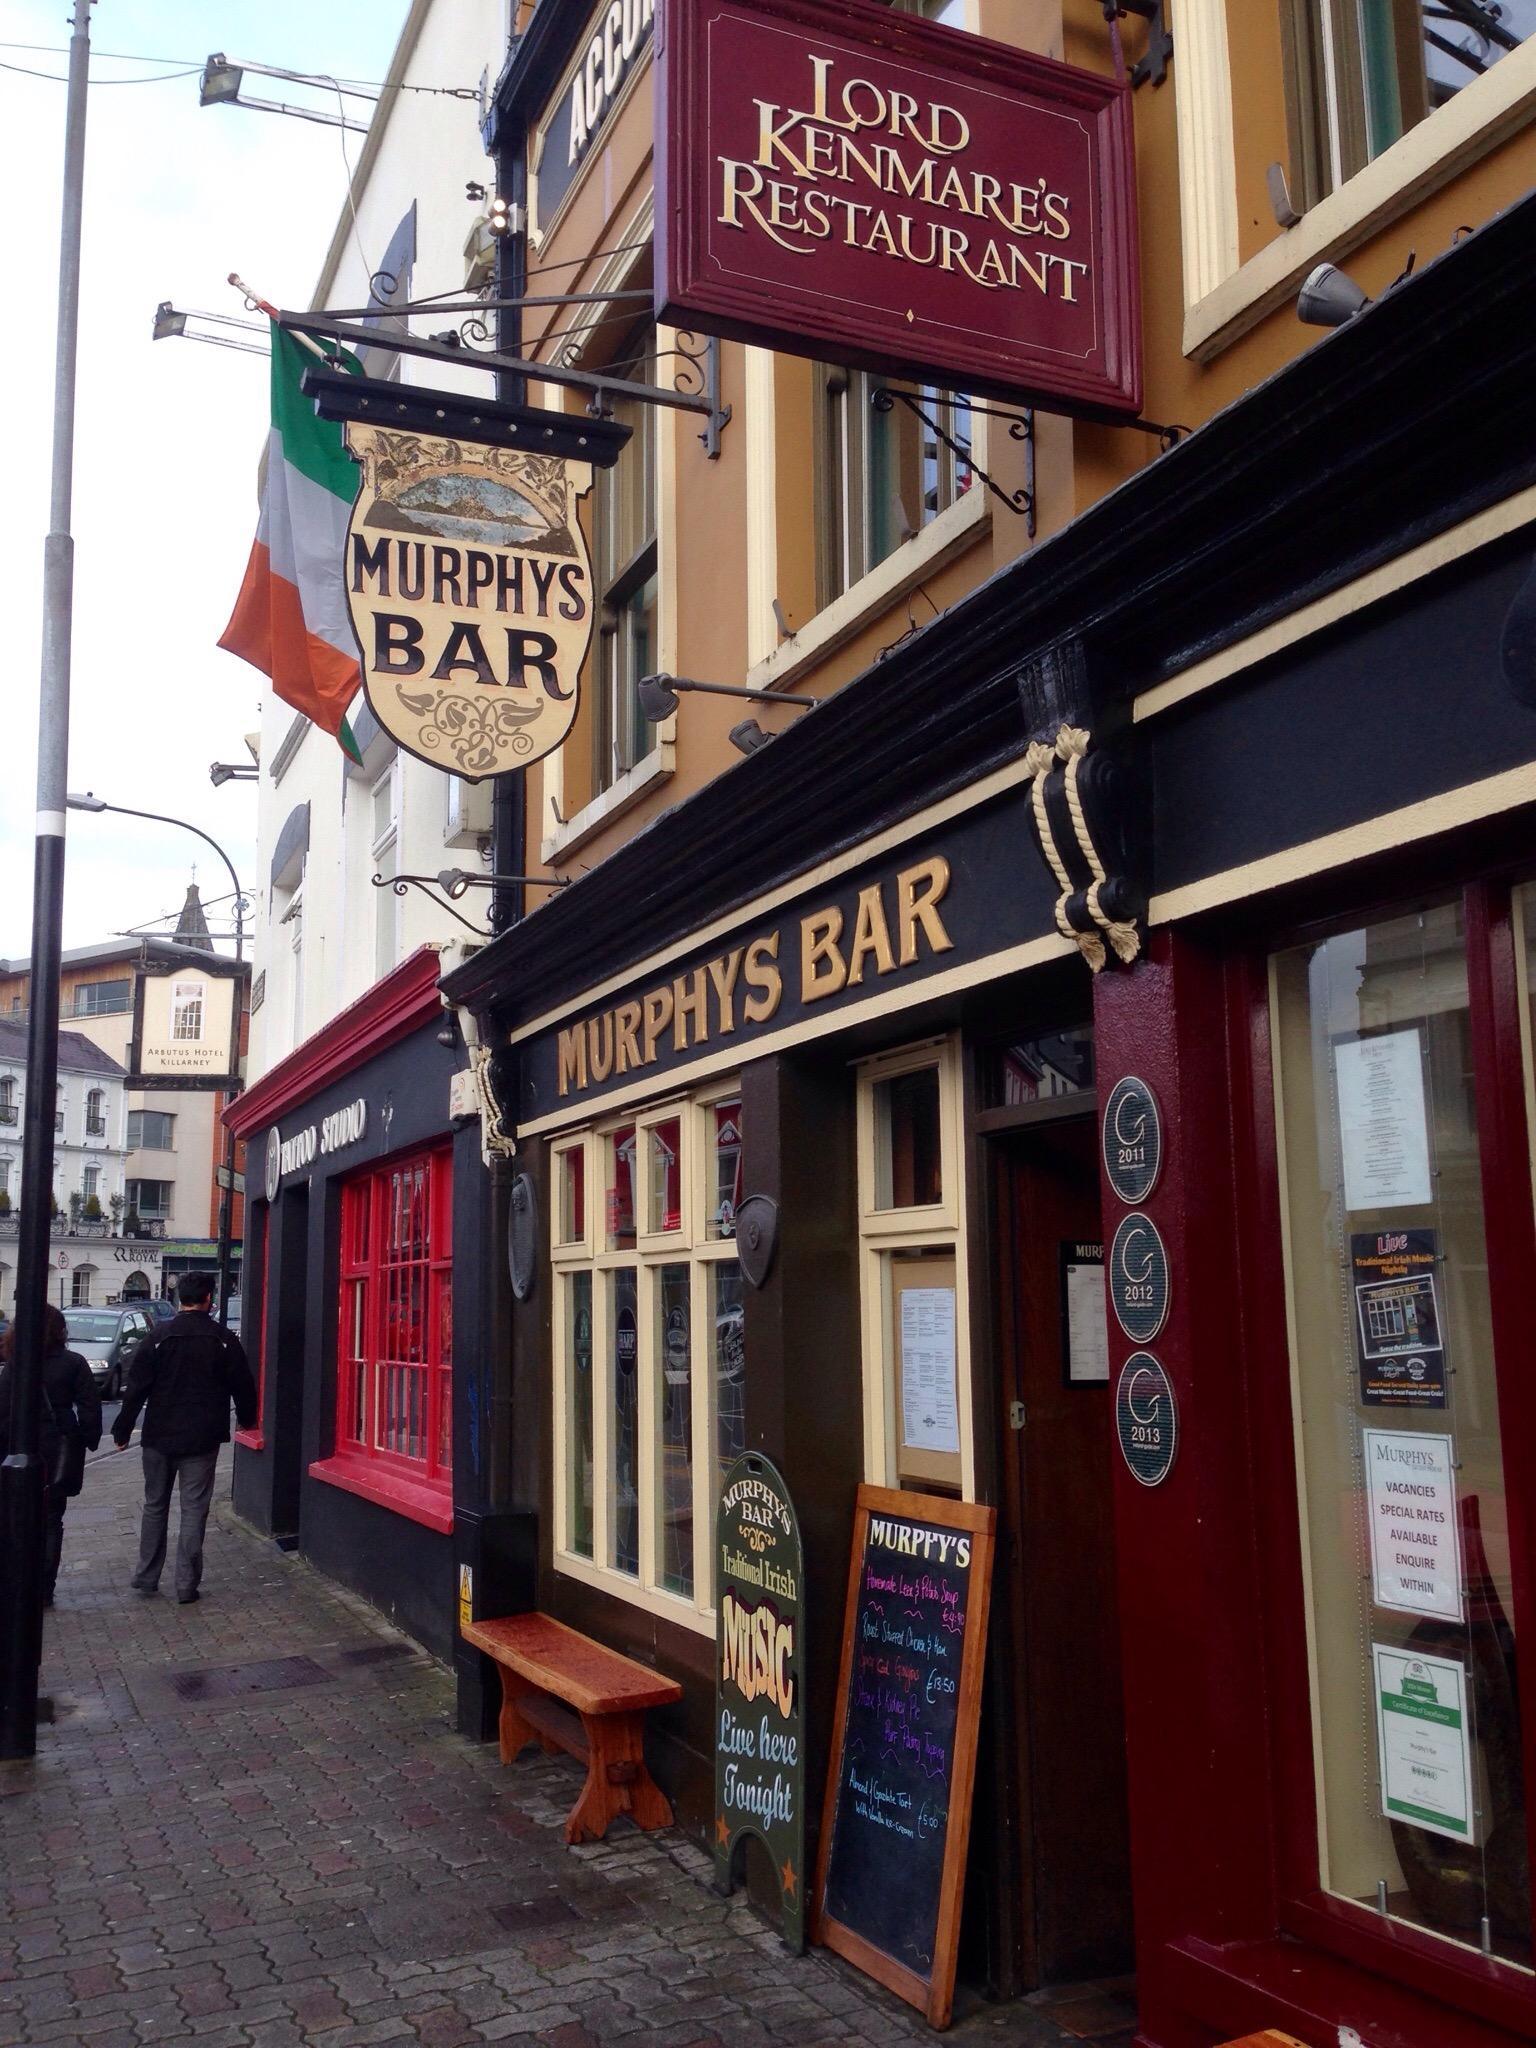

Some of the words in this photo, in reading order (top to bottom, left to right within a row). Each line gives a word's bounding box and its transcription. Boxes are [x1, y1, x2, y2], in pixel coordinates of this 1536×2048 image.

[807, 54, 971, 155] LORD
[752, 98, 1071, 240] KENMARE'S
[717, 156, 1088, 303] RESTAURANT
[351, 532, 586, 622] MURPHYS
[371, 611, 575, 701] BAR
[557, 930, 783, 1097] MURPHYS
[800, 855, 955, 1004] BAR
[147, 1048, 190, 1056] ARBUTUS
[194, 1049, 224, 1057] HOTEL
[160, 1058, 211, 1066] KILLARNEY
[320, 1098, 367, 1155] STUDIO
[1118, 1147, 1146, 1164] 2011
[1377, 1233, 1409, 1256] Live
[129, 1253, 159, 1263] ROYAL
[1412, 1253, 1435, 1263] Music
[1125, 1285, 1154, 1301] 2012
[1131, 1426, 1161, 1443] 2013
[1376, 1443, 1435, 1466] MURPHYS
[1385, 1481, 1436, 1498] VACANCIES
[722, 1479, 792, 1536] MURPHY'S
[741, 1501, 774, 1529] BAR
[1380, 1504, 1415, 1519] SPECIAL
[1416, 1508, 1445, 1523] RATES
[1390, 1529, 1438, 1546] AVAILABLE
[722, 1544, 763, 1588] Traditional
[765, 1560, 797, 1601] Irish
[1396, 1553, 1436, 1570] ENQUIRE
[1399, 1577, 1435, 1594] WITHIN
[722, 1594, 793, 1719] MUSIC
[718, 1708, 756, 1758] Live
[759, 1715, 798, 1767] here
[723, 1763, 794, 1832] Tonight
